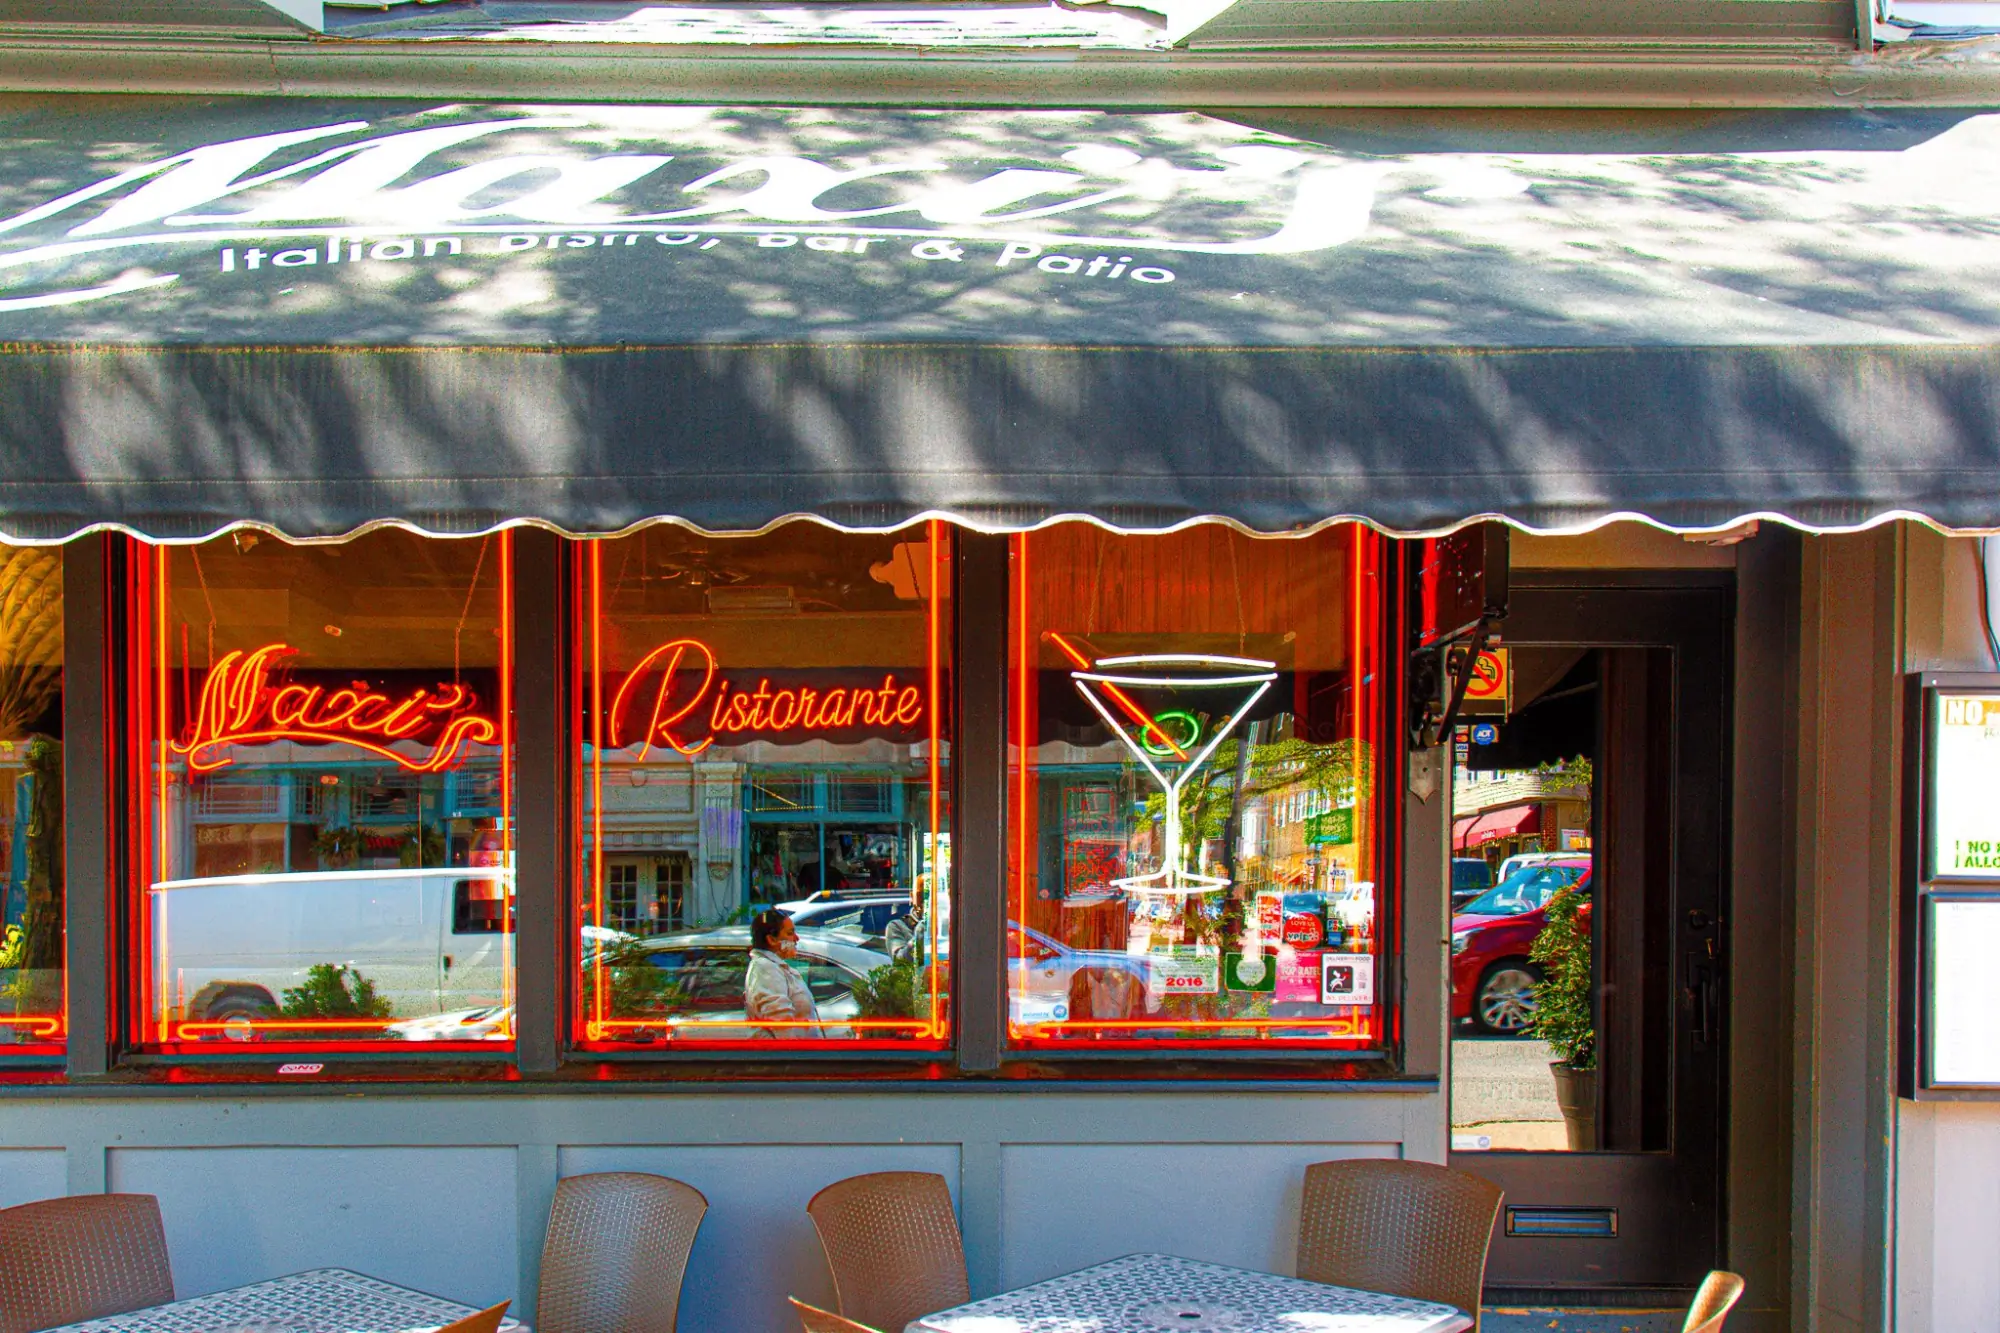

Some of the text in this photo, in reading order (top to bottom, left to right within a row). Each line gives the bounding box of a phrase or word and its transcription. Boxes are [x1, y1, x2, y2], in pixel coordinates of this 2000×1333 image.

[221, 233, 462, 274] Italian
[910, 239, 965, 263] &
[996, 240, 1176, 285] Patio
[170, 642, 495, 772] Maxi's
[610, 638, 923, 763] Ristorante
[1947, 699, 1983, 725] NO
[1476, 730, 1492, 738] ADT
[1967, 840, 1991, 853] NO
[1165, 976, 1203, 987] 2016
